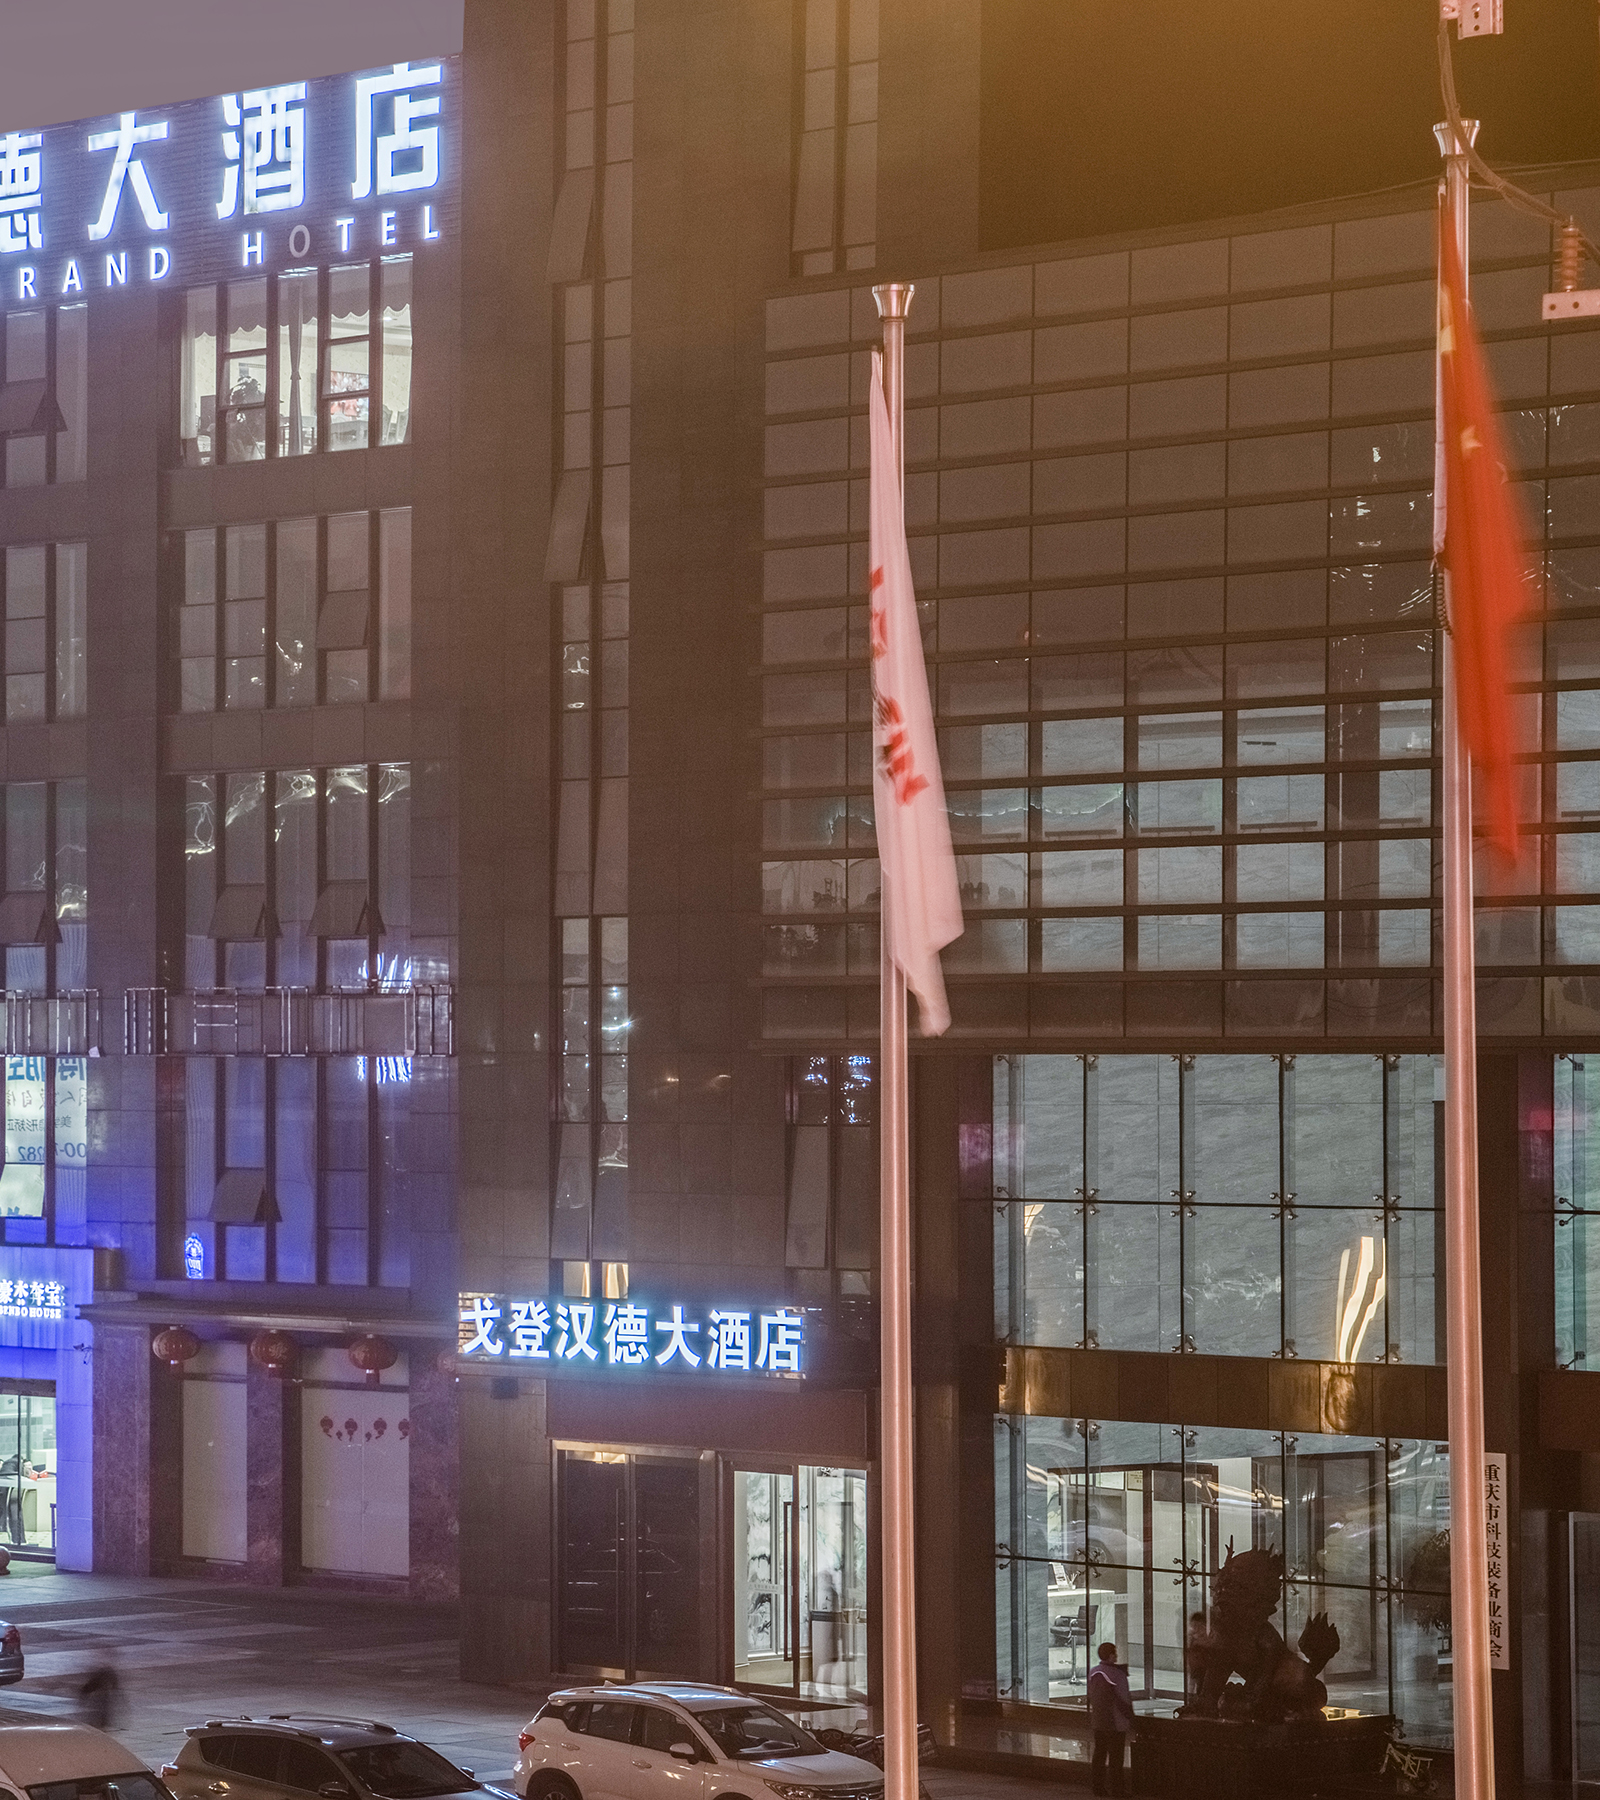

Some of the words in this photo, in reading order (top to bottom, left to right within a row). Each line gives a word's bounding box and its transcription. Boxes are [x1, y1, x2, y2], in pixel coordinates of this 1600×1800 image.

[242, 205, 441, 267] HOTEL
[29, 1307, 61, 1319] HOUSE
[460, 1297, 803, 1371] 戈登汉德大酒店
